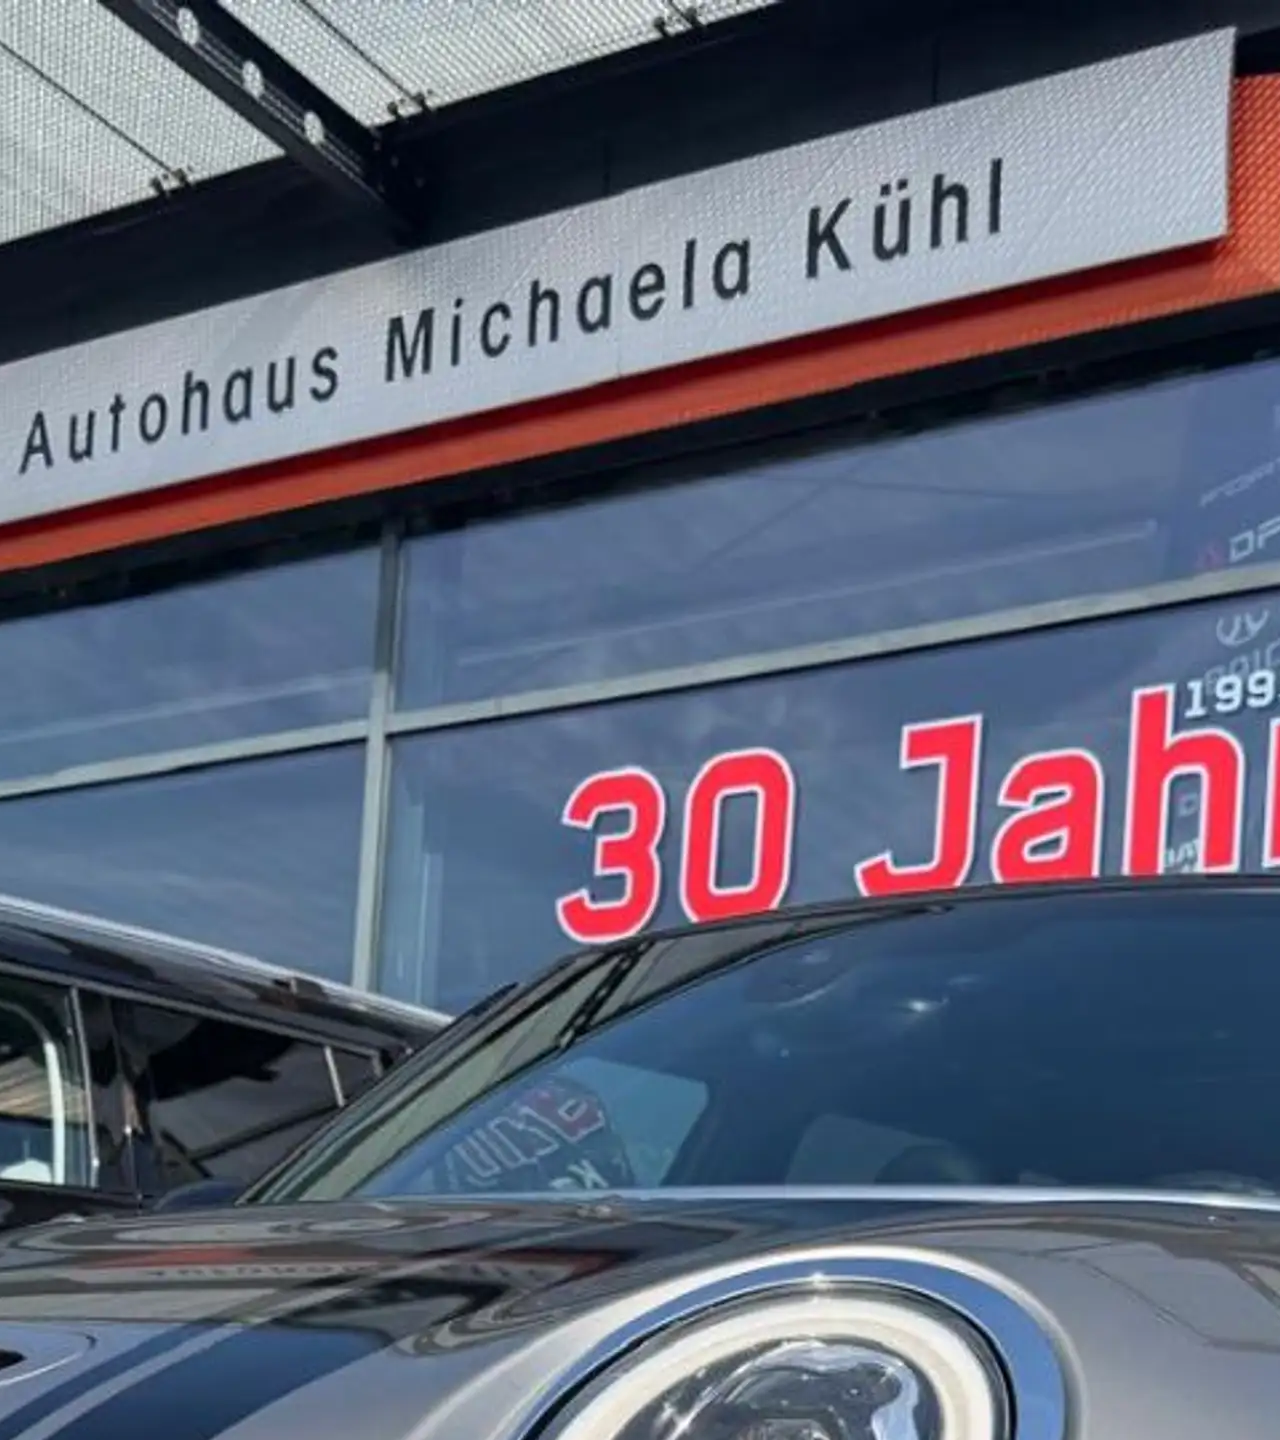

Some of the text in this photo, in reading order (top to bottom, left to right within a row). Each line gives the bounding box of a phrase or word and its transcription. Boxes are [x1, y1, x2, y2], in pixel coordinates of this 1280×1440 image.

[19, 158, 1003, 474] Autohaus Michaela Kühl
[556, 747, 795, 943] 30
